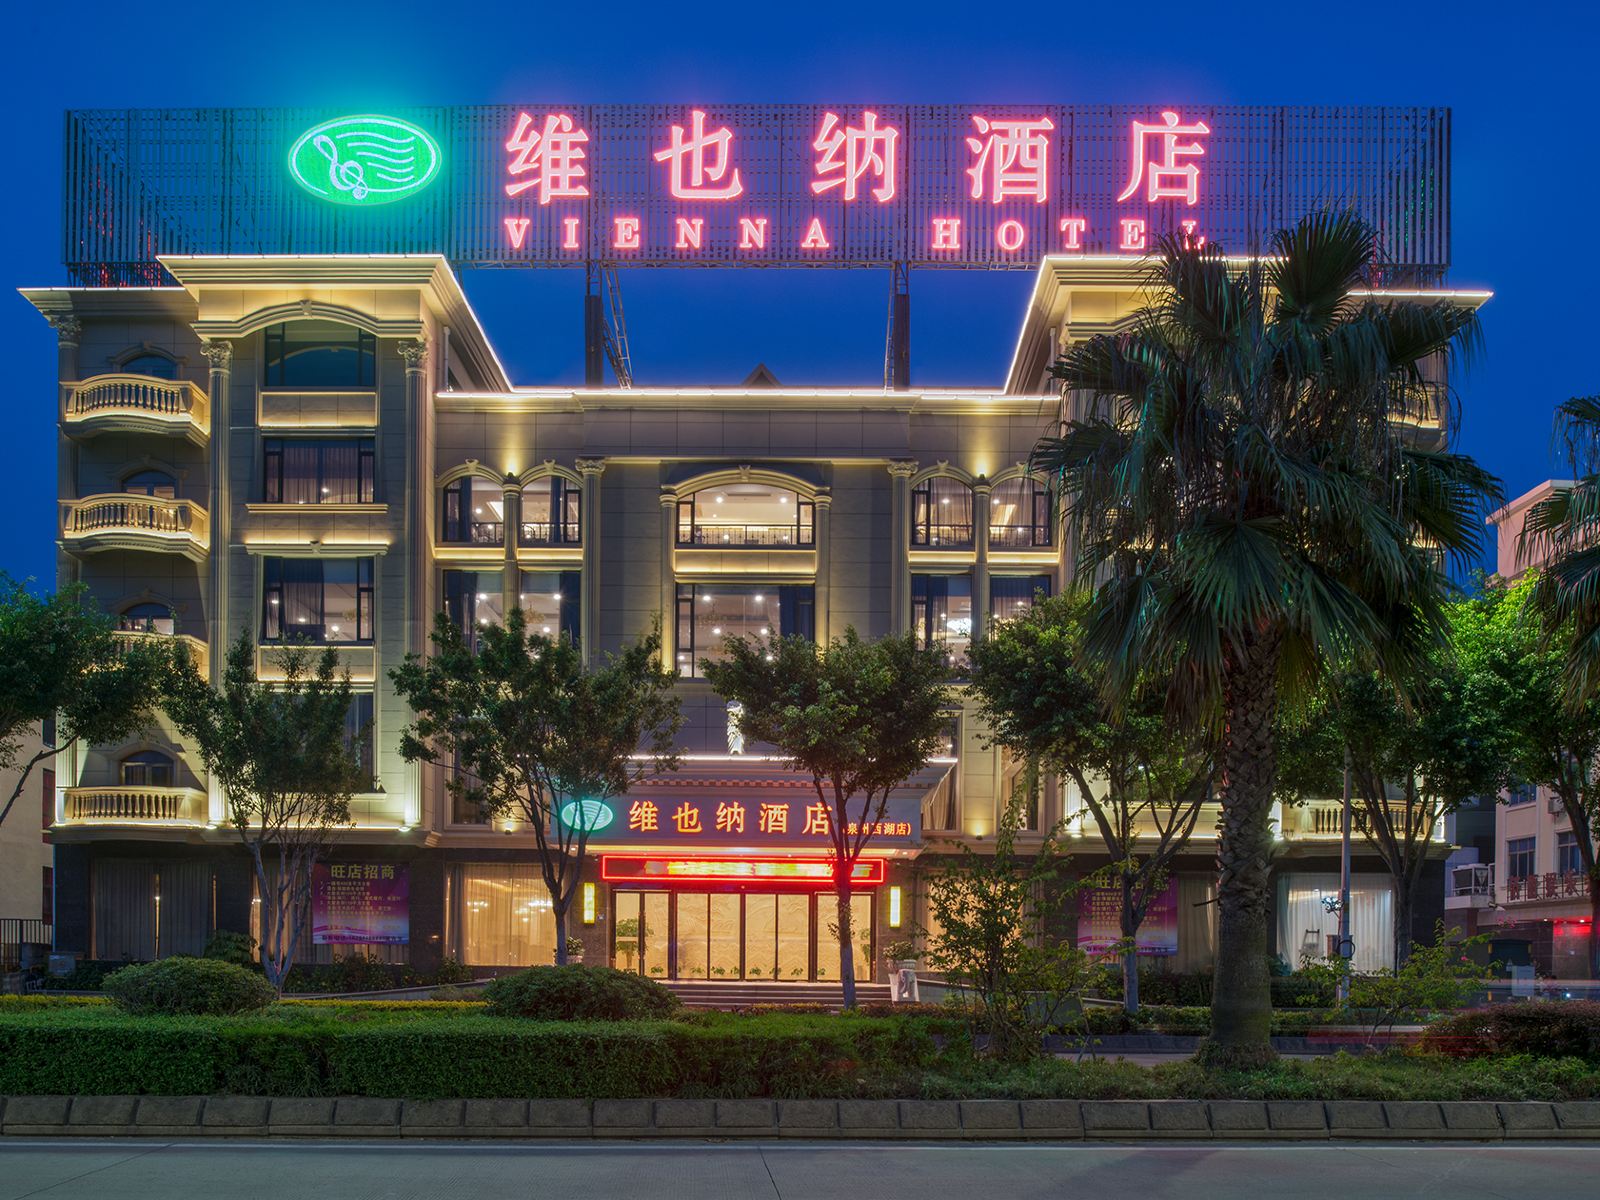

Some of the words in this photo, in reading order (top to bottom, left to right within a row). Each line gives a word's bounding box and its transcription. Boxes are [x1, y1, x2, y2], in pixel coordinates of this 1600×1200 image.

[505, 111, 1210, 205] 维也纳酒店
[503, 217, 831, 250] VIENNA
[628, 800, 833, 835] 维也纳酒店
[330, 864, 395, 879] 旺店招商
